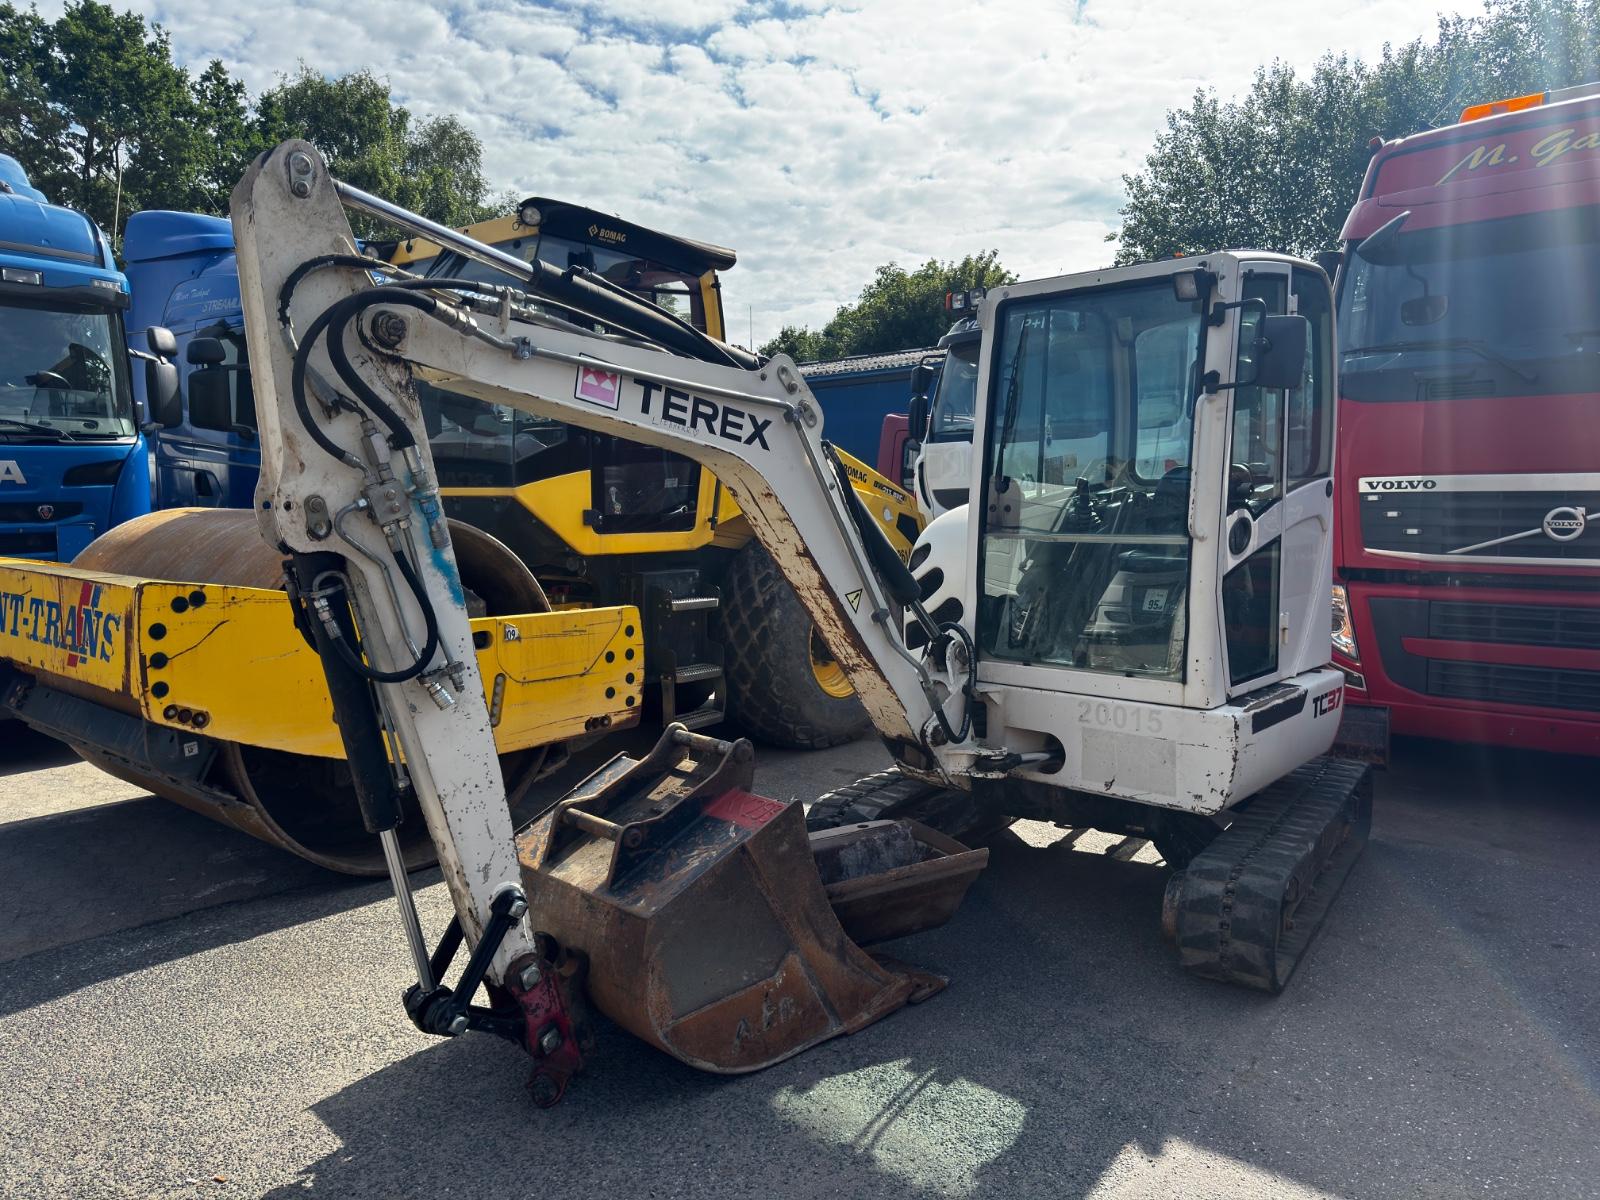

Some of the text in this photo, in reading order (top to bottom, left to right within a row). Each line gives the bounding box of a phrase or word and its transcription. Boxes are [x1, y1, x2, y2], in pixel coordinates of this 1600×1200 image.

[1434, 143, 1518, 187] M.
[599, 228, 627, 243] BOMAG
[633, 377, 773, 452] TEREX
[1365, 480, 1437, 490] VOLVO
[1078, 701, 1162, 733] 20015
[1313, 686, 1343, 719] TC37
